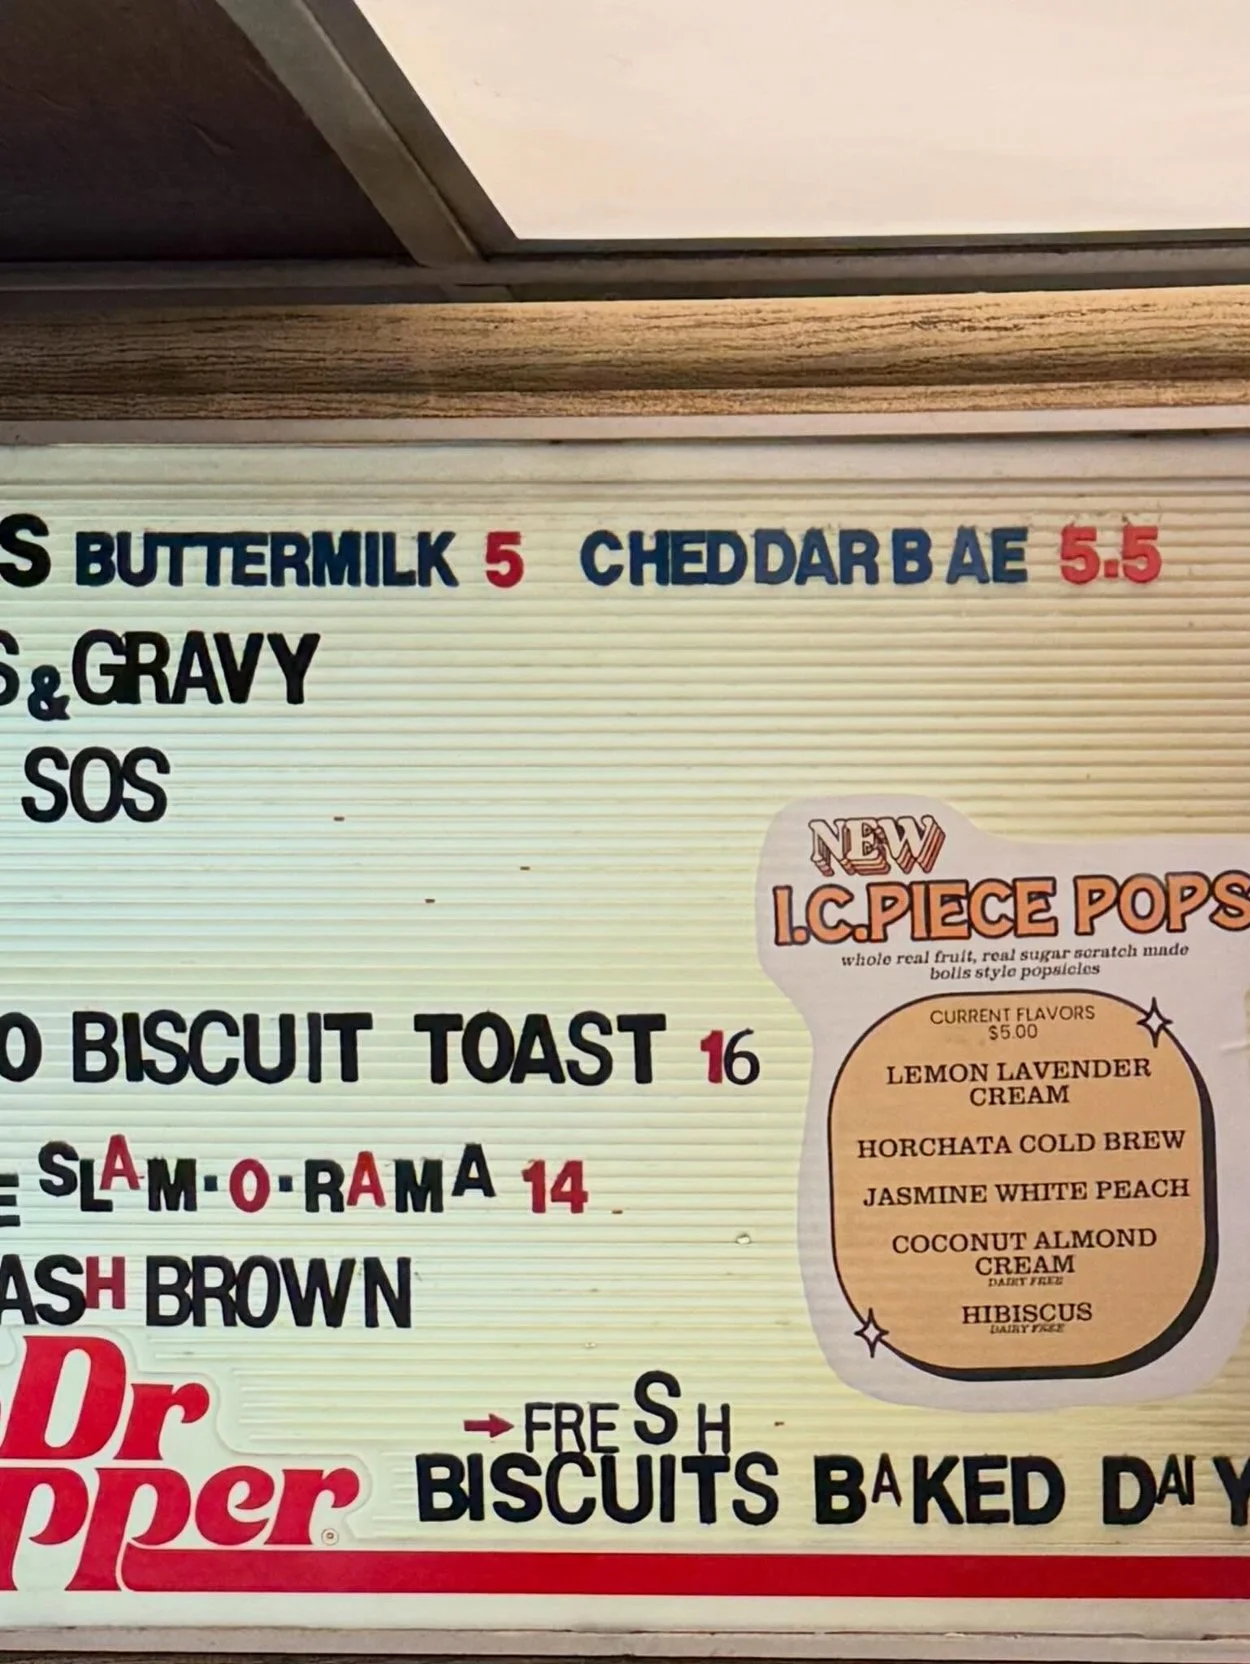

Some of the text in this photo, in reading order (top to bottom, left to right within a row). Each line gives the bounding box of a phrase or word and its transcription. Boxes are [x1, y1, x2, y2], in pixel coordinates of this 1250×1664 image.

[75, 529, 459, 588] BUTTERMILK
[485, 530, 525, 589] 5
[1060, 524, 1163, 585] 5.5
[21, 746, 170, 823] SOS
[808, 814, 946, 876] NEW
[841, 942, 1190, 968] whole real fruit, real sugar scratch made
[974, 963, 1017, 982] style
[1020, 962, 1101, 980] popsicles
[929, 1004, 1096, 1026] CURRENT FLAVORS
[988, 1022, 1039, 1042] $5.00
[72, 1010, 373, 1086] BISCUIT
[413, 1010, 668, 1086] TOAST
[700, 1027, 761, 1086] 16
[886, 1057, 1152, 1086] LEMON LAVENDER
[969, 1084, 1071, 1107] CREAM
[857, 1130, 1187, 1159] HORCHATA COLD BREW
[521, 1159, 589, 1214] 14
[863, 1177, 1191, 1208] JASMINE WHITE PEACH
[891, 1227, 1158, 1255] COCONUT ALMOND
[975, 1254, 1075, 1277] CREAM
[146, 1255, 412, 1328] BROWN
[988, 1275, 1064, 1288] DAIRY FREE
[961, 1302, 1093, 1325] HIBISCUS
[990, 1323, 1066, 1335] DAIRY FREE
[0, 1335, 210, 1460] Dr
[523, 1370, 731, 1453] FRESH
[415, 1452, 780, 1526] BISCUITS
[814, 1451, 1066, 1526] BAKED
